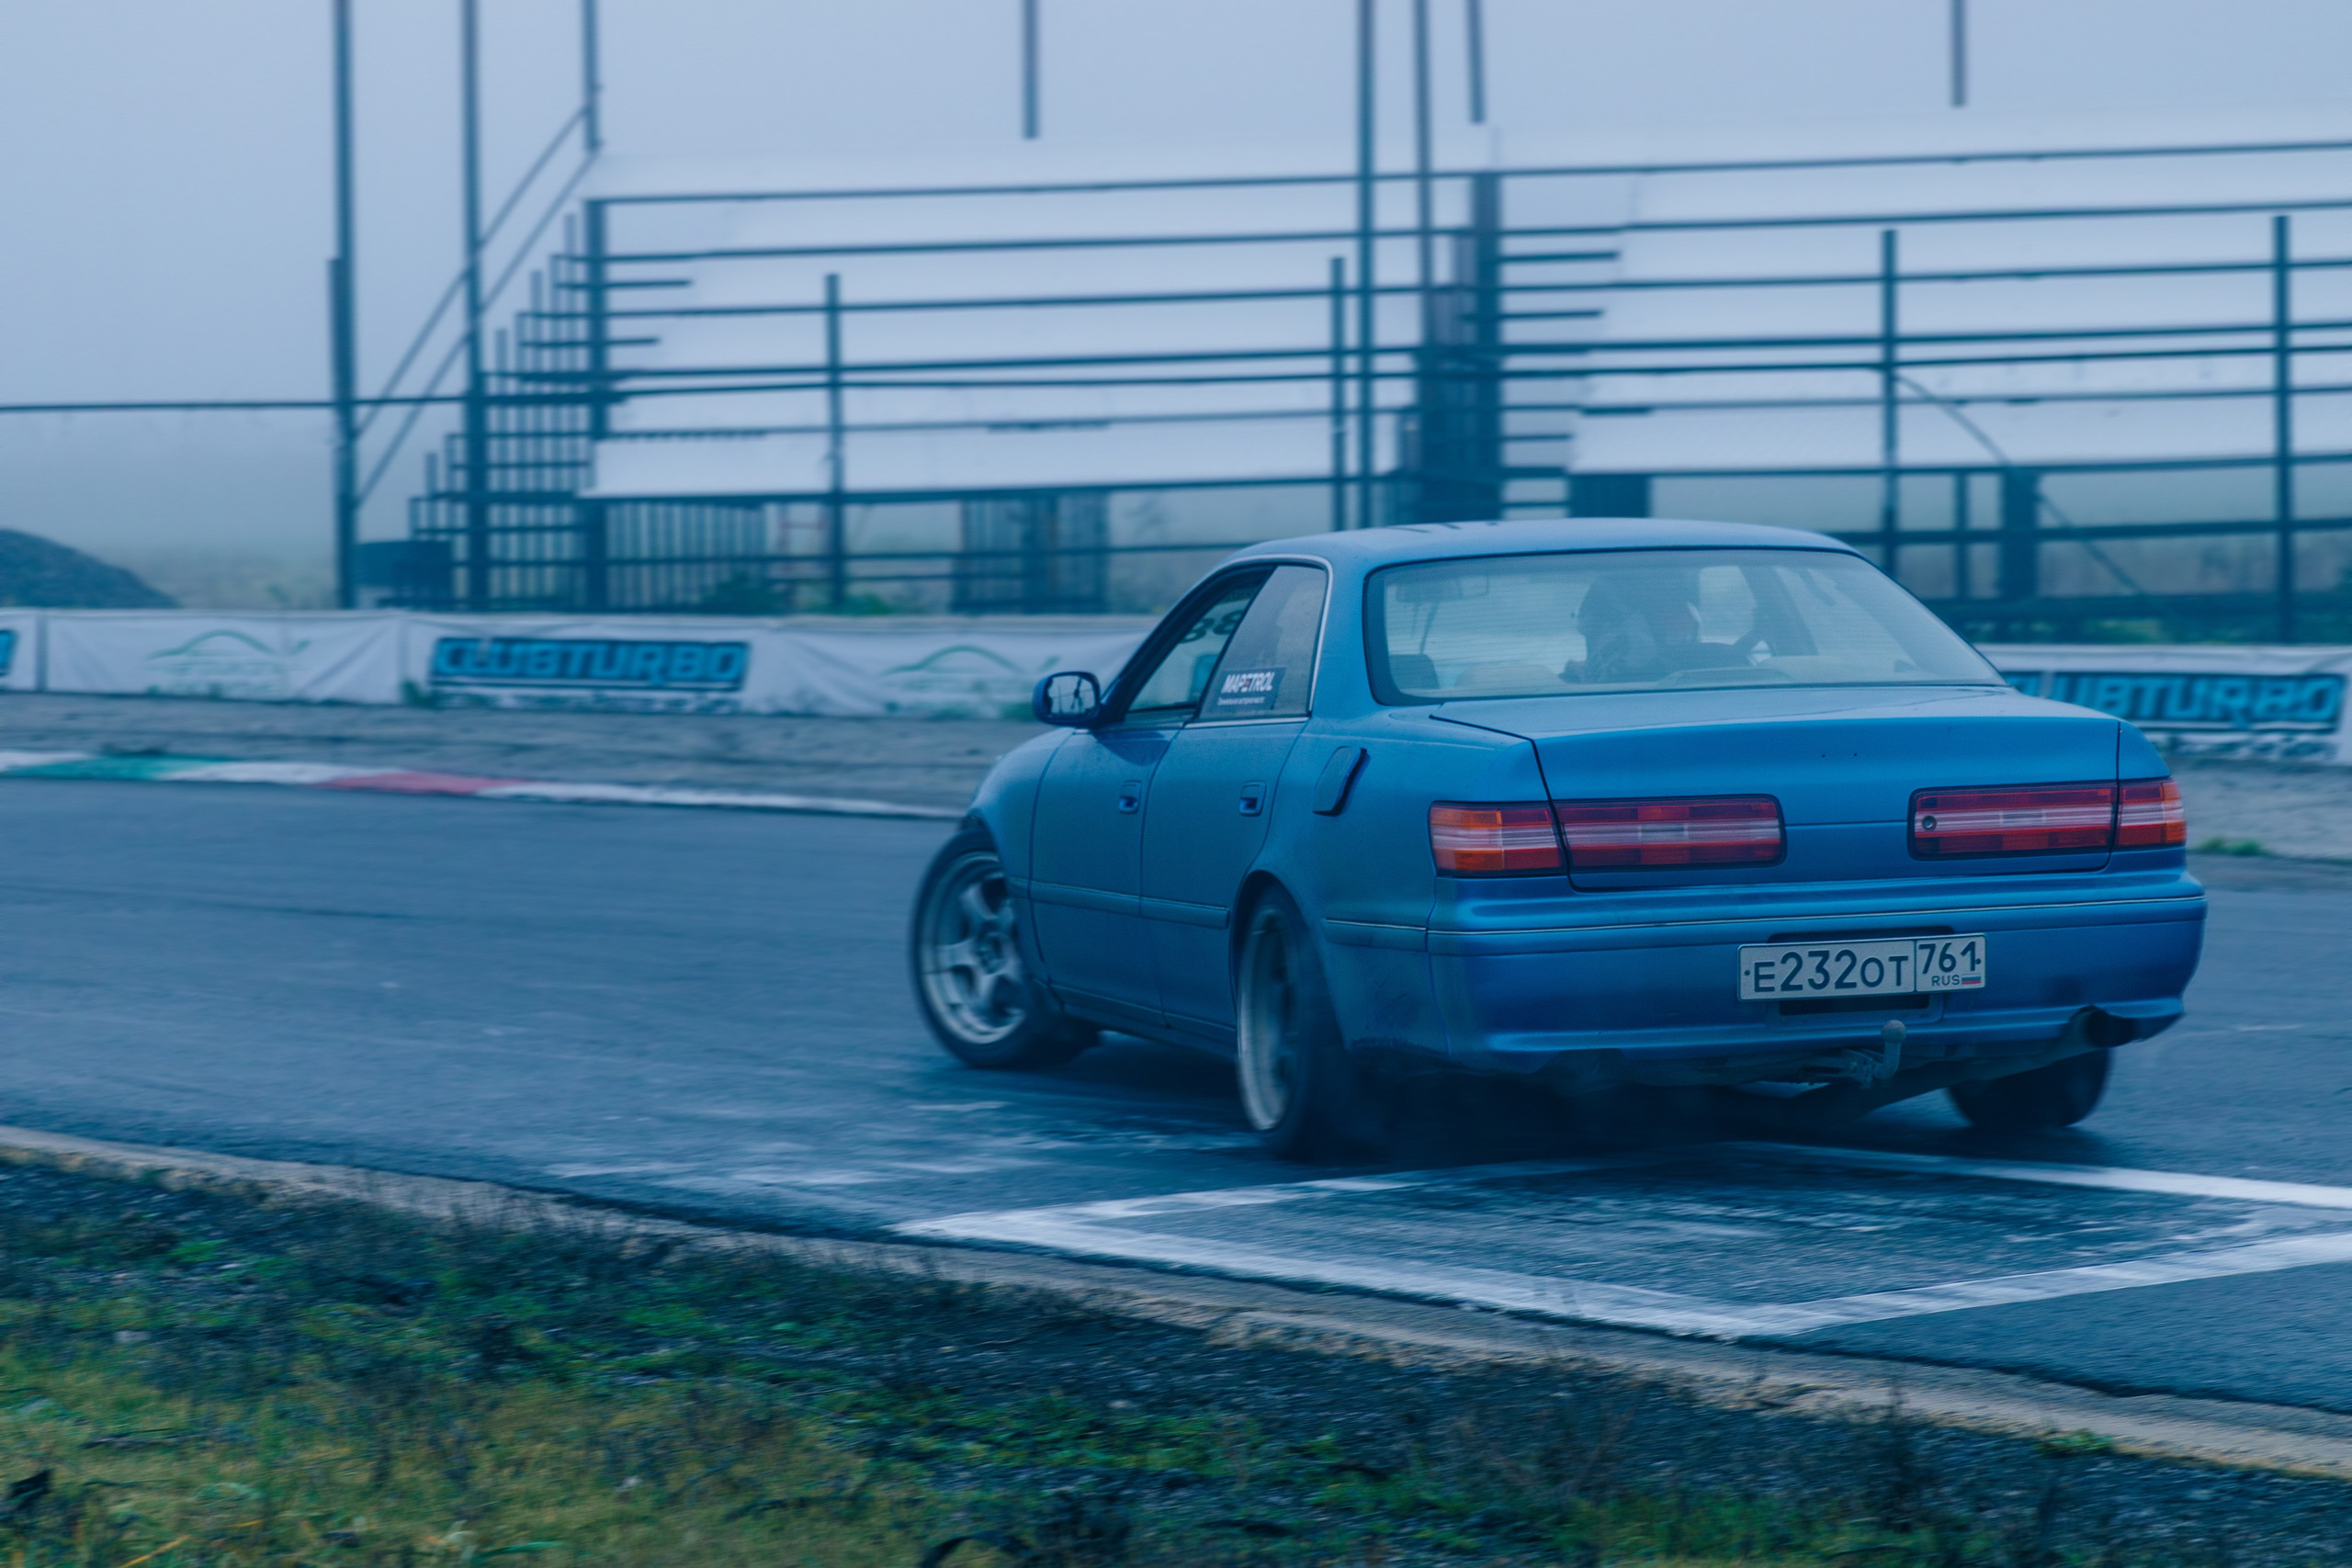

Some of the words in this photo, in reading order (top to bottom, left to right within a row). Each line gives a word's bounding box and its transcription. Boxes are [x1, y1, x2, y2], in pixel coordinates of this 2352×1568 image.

[1221, 671, 1275, 694] MAPETROL
[1918, 941, 1976, 975] 761
[1931, 974, 1960, 986] RUS
